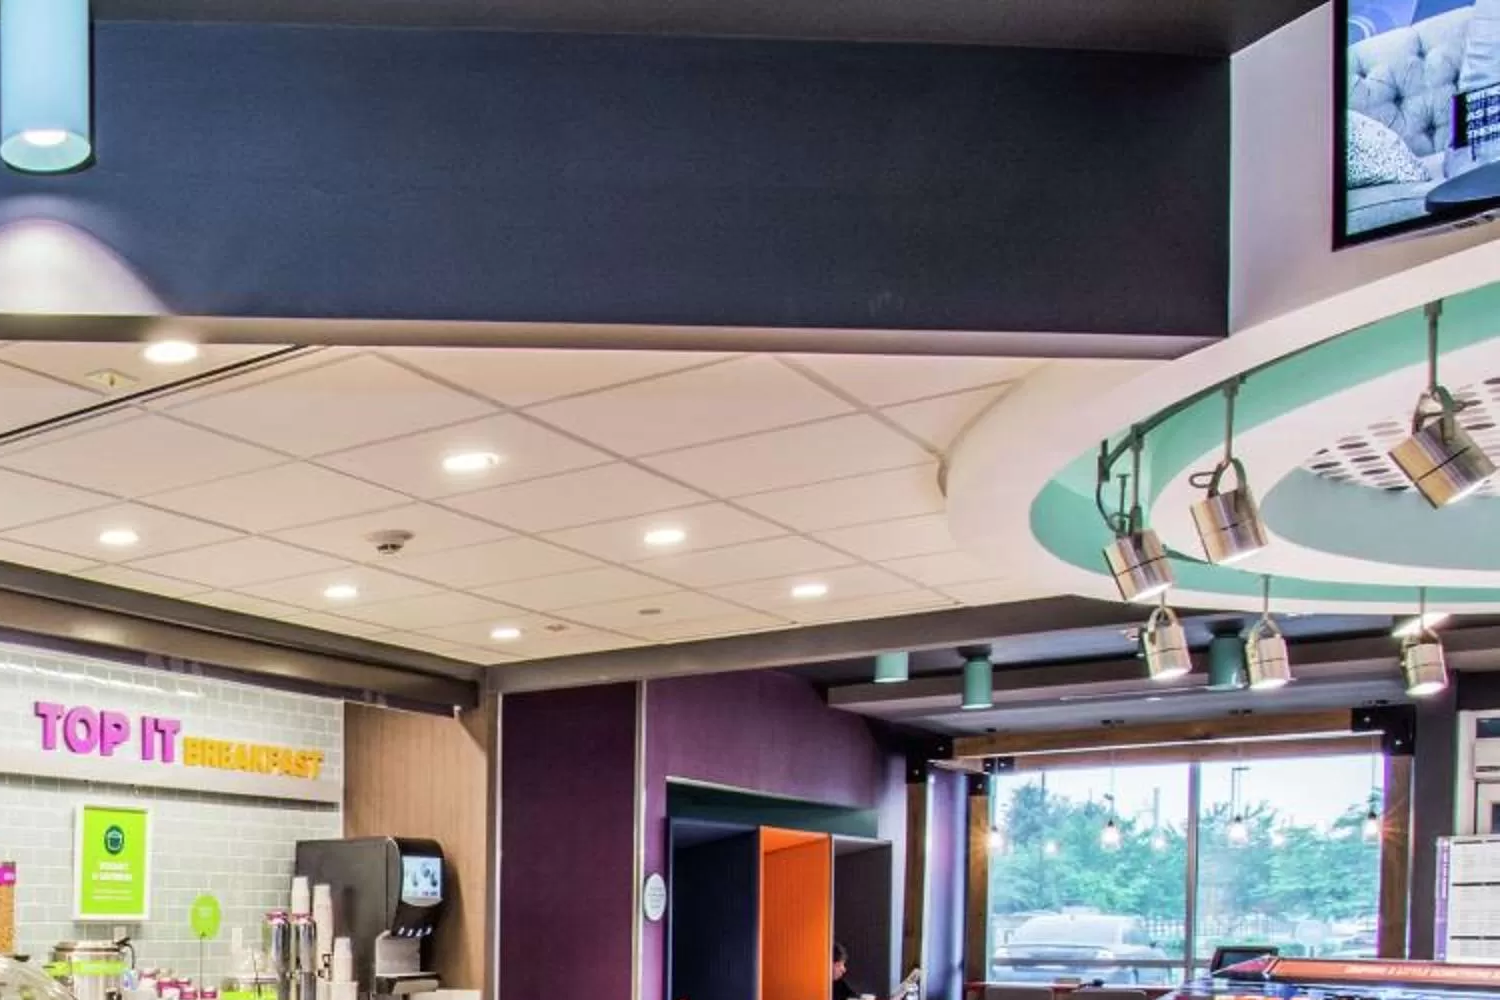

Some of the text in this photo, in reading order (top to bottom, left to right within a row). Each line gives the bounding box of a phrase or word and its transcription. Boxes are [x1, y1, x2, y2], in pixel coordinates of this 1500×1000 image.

[34, 701, 180, 763] TOP IT
[183, 736, 325, 780] BREAKFAST
